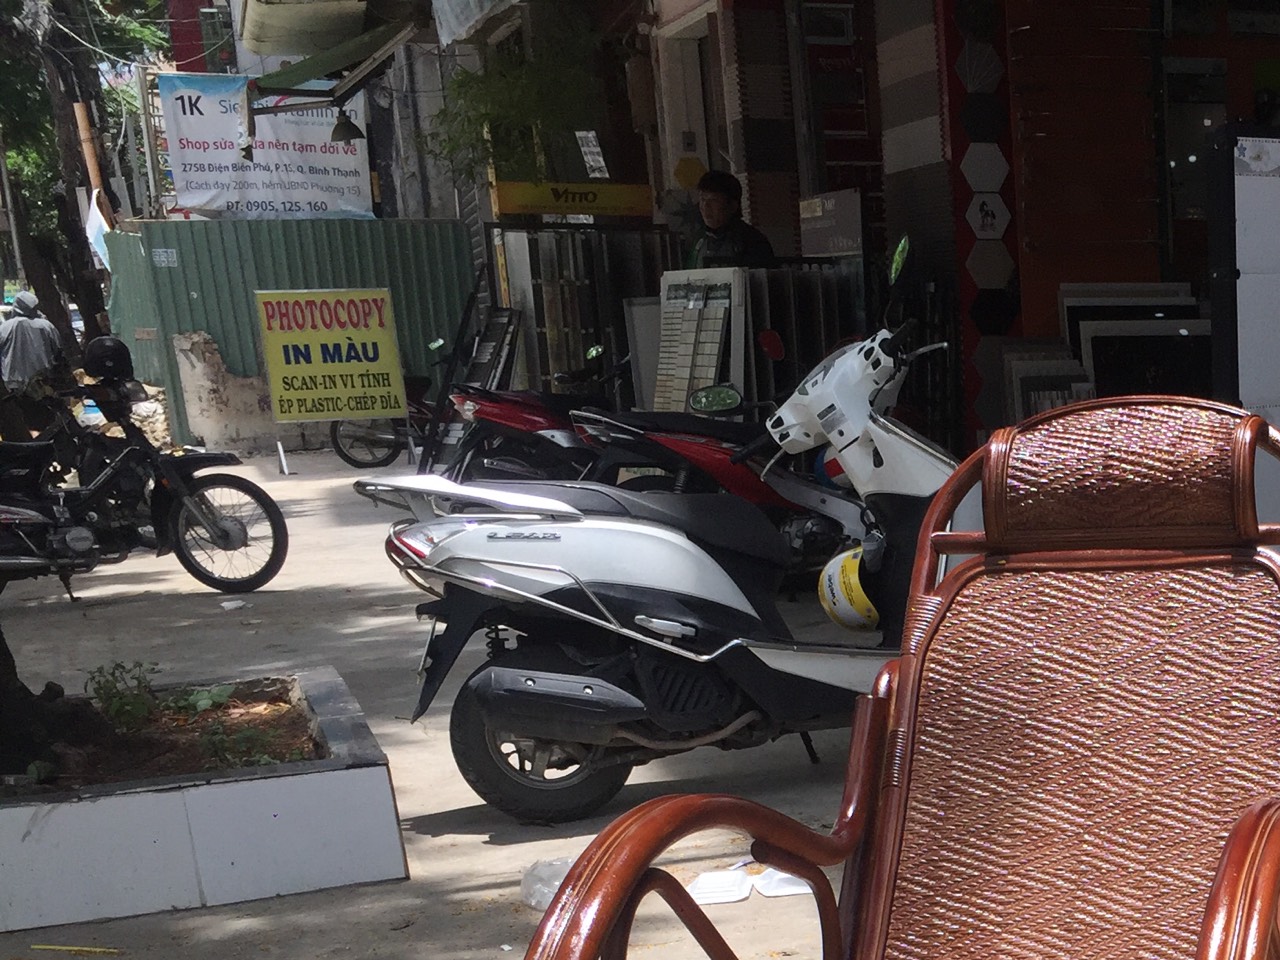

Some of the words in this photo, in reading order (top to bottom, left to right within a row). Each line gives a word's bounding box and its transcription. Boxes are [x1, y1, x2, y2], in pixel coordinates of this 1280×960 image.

[175, 95, 204, 116] 1K
[178, 137, 210, 152] Shop
[292, 141, 317, 154] tạm
[226, 200, 244, 212] ĐT:
[306, 200, 328, 212] 160
[262, 297, 386, 331] PHOTOCOPY
[282, 343, 313, 365] IN
[320, 336, 380, 364] MÀU
[282, 373, 338, 392] SCAN-IN
[338, 373, 356, 389] VI
[358, 369, 392, 389] TÍNH
[278, 395, 294, 414] ÉP
